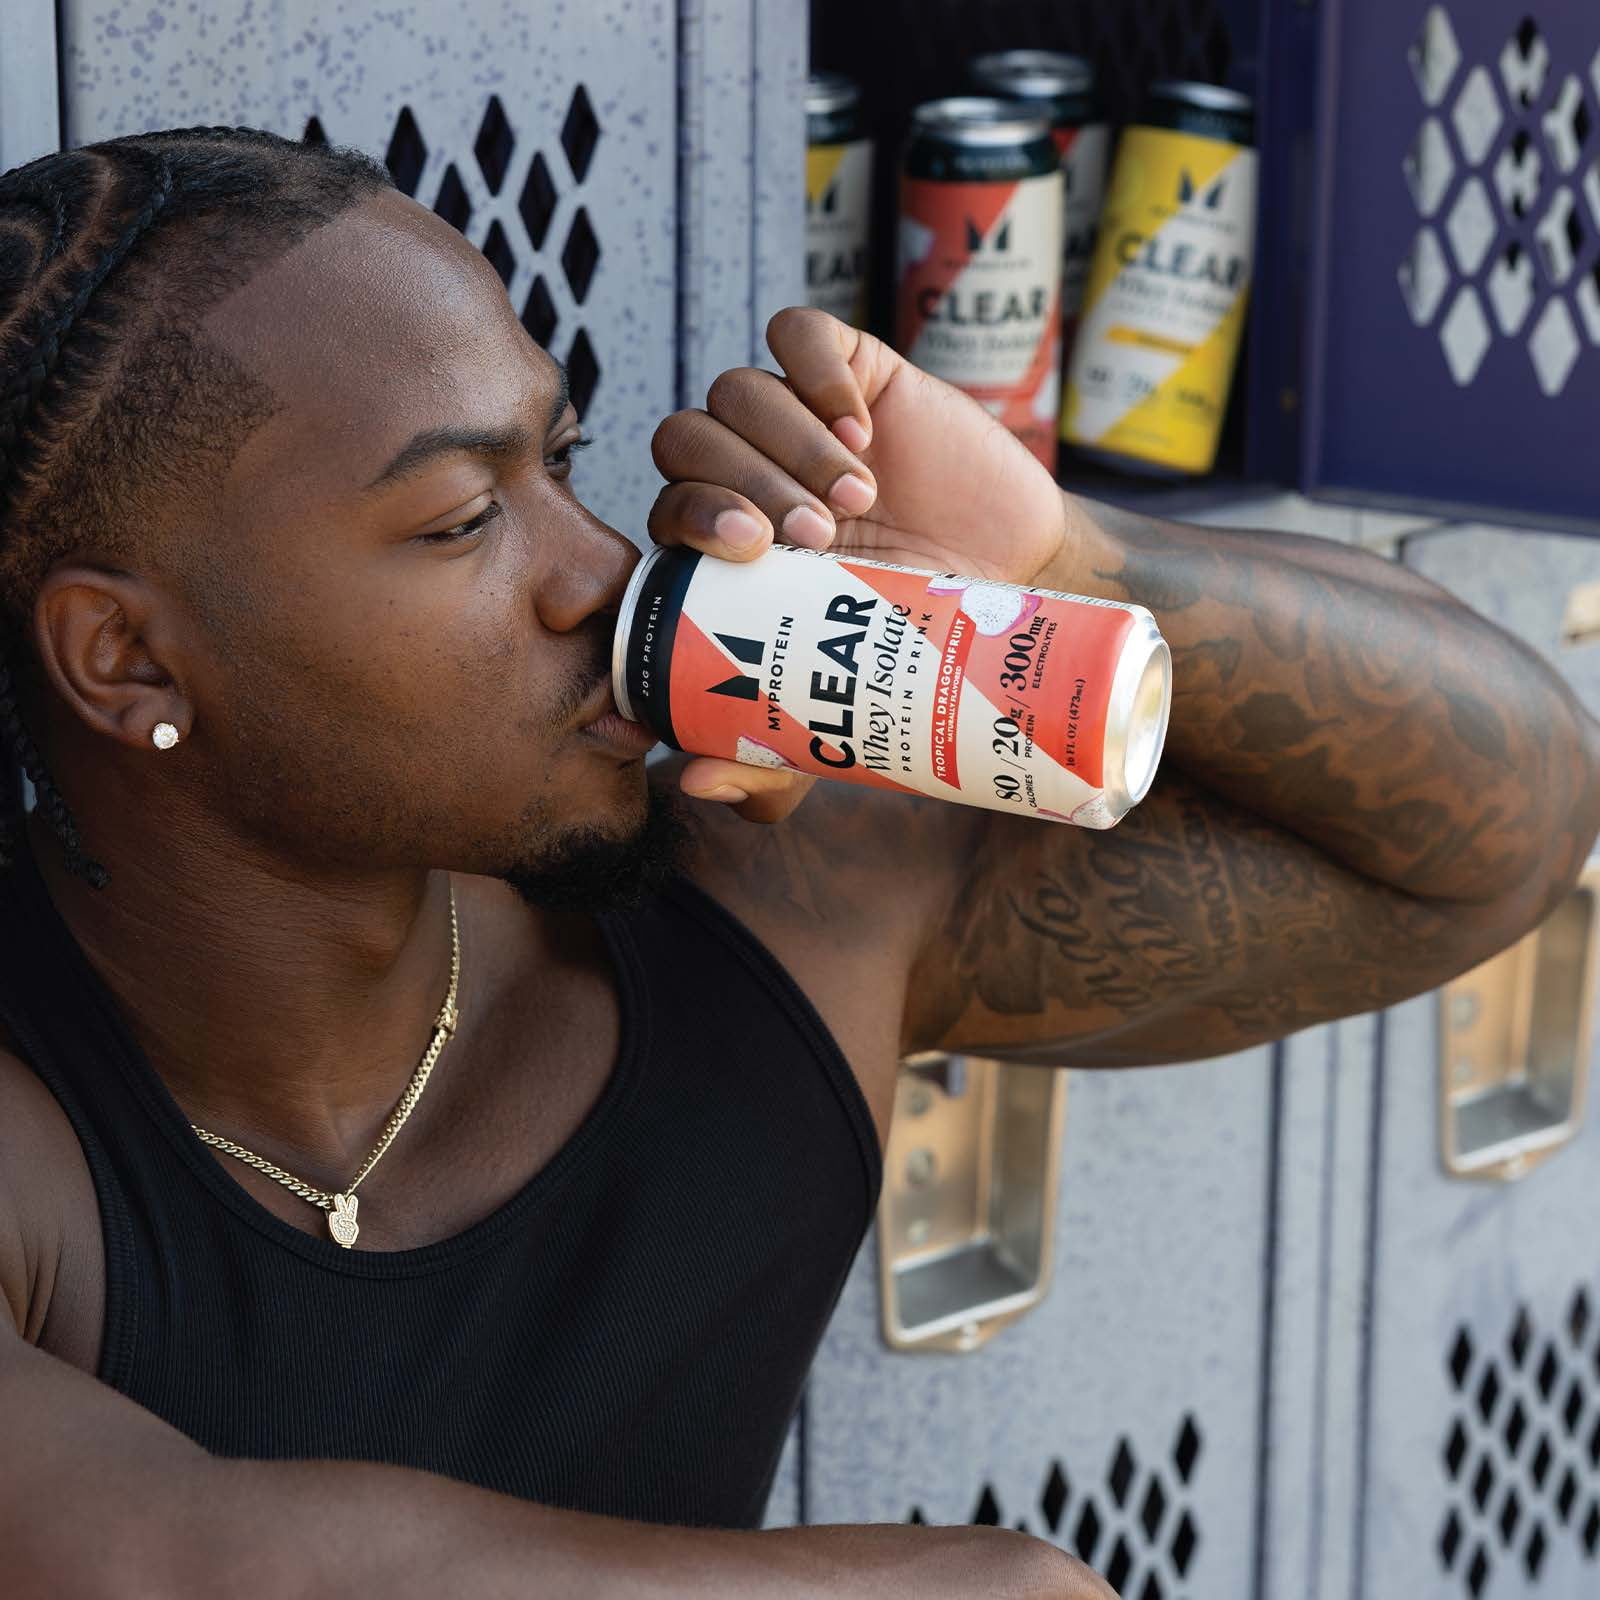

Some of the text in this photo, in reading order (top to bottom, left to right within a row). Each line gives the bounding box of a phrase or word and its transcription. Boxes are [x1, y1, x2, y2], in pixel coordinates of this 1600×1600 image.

[640, 595, 663, 698] 20G PROTEIN
[767, 615, 794, 731] MYPROTEIN
[808, 594, 879, 769] CLEAR
[862, 604, 912, 771] Whey Isolate
[900, 612, 933, 773] PROTEIN DRINK
[933, 617, 967, 779] TROPICAL DRAGONFRUIT
[947, 665, 962, 743] NATURALLY FLAVORED
[992, 615, 1049, 803] 80 20g 300mg
[1024, 622, 1058, 809] CALORIES PROTEIN ELECTROLYTES
